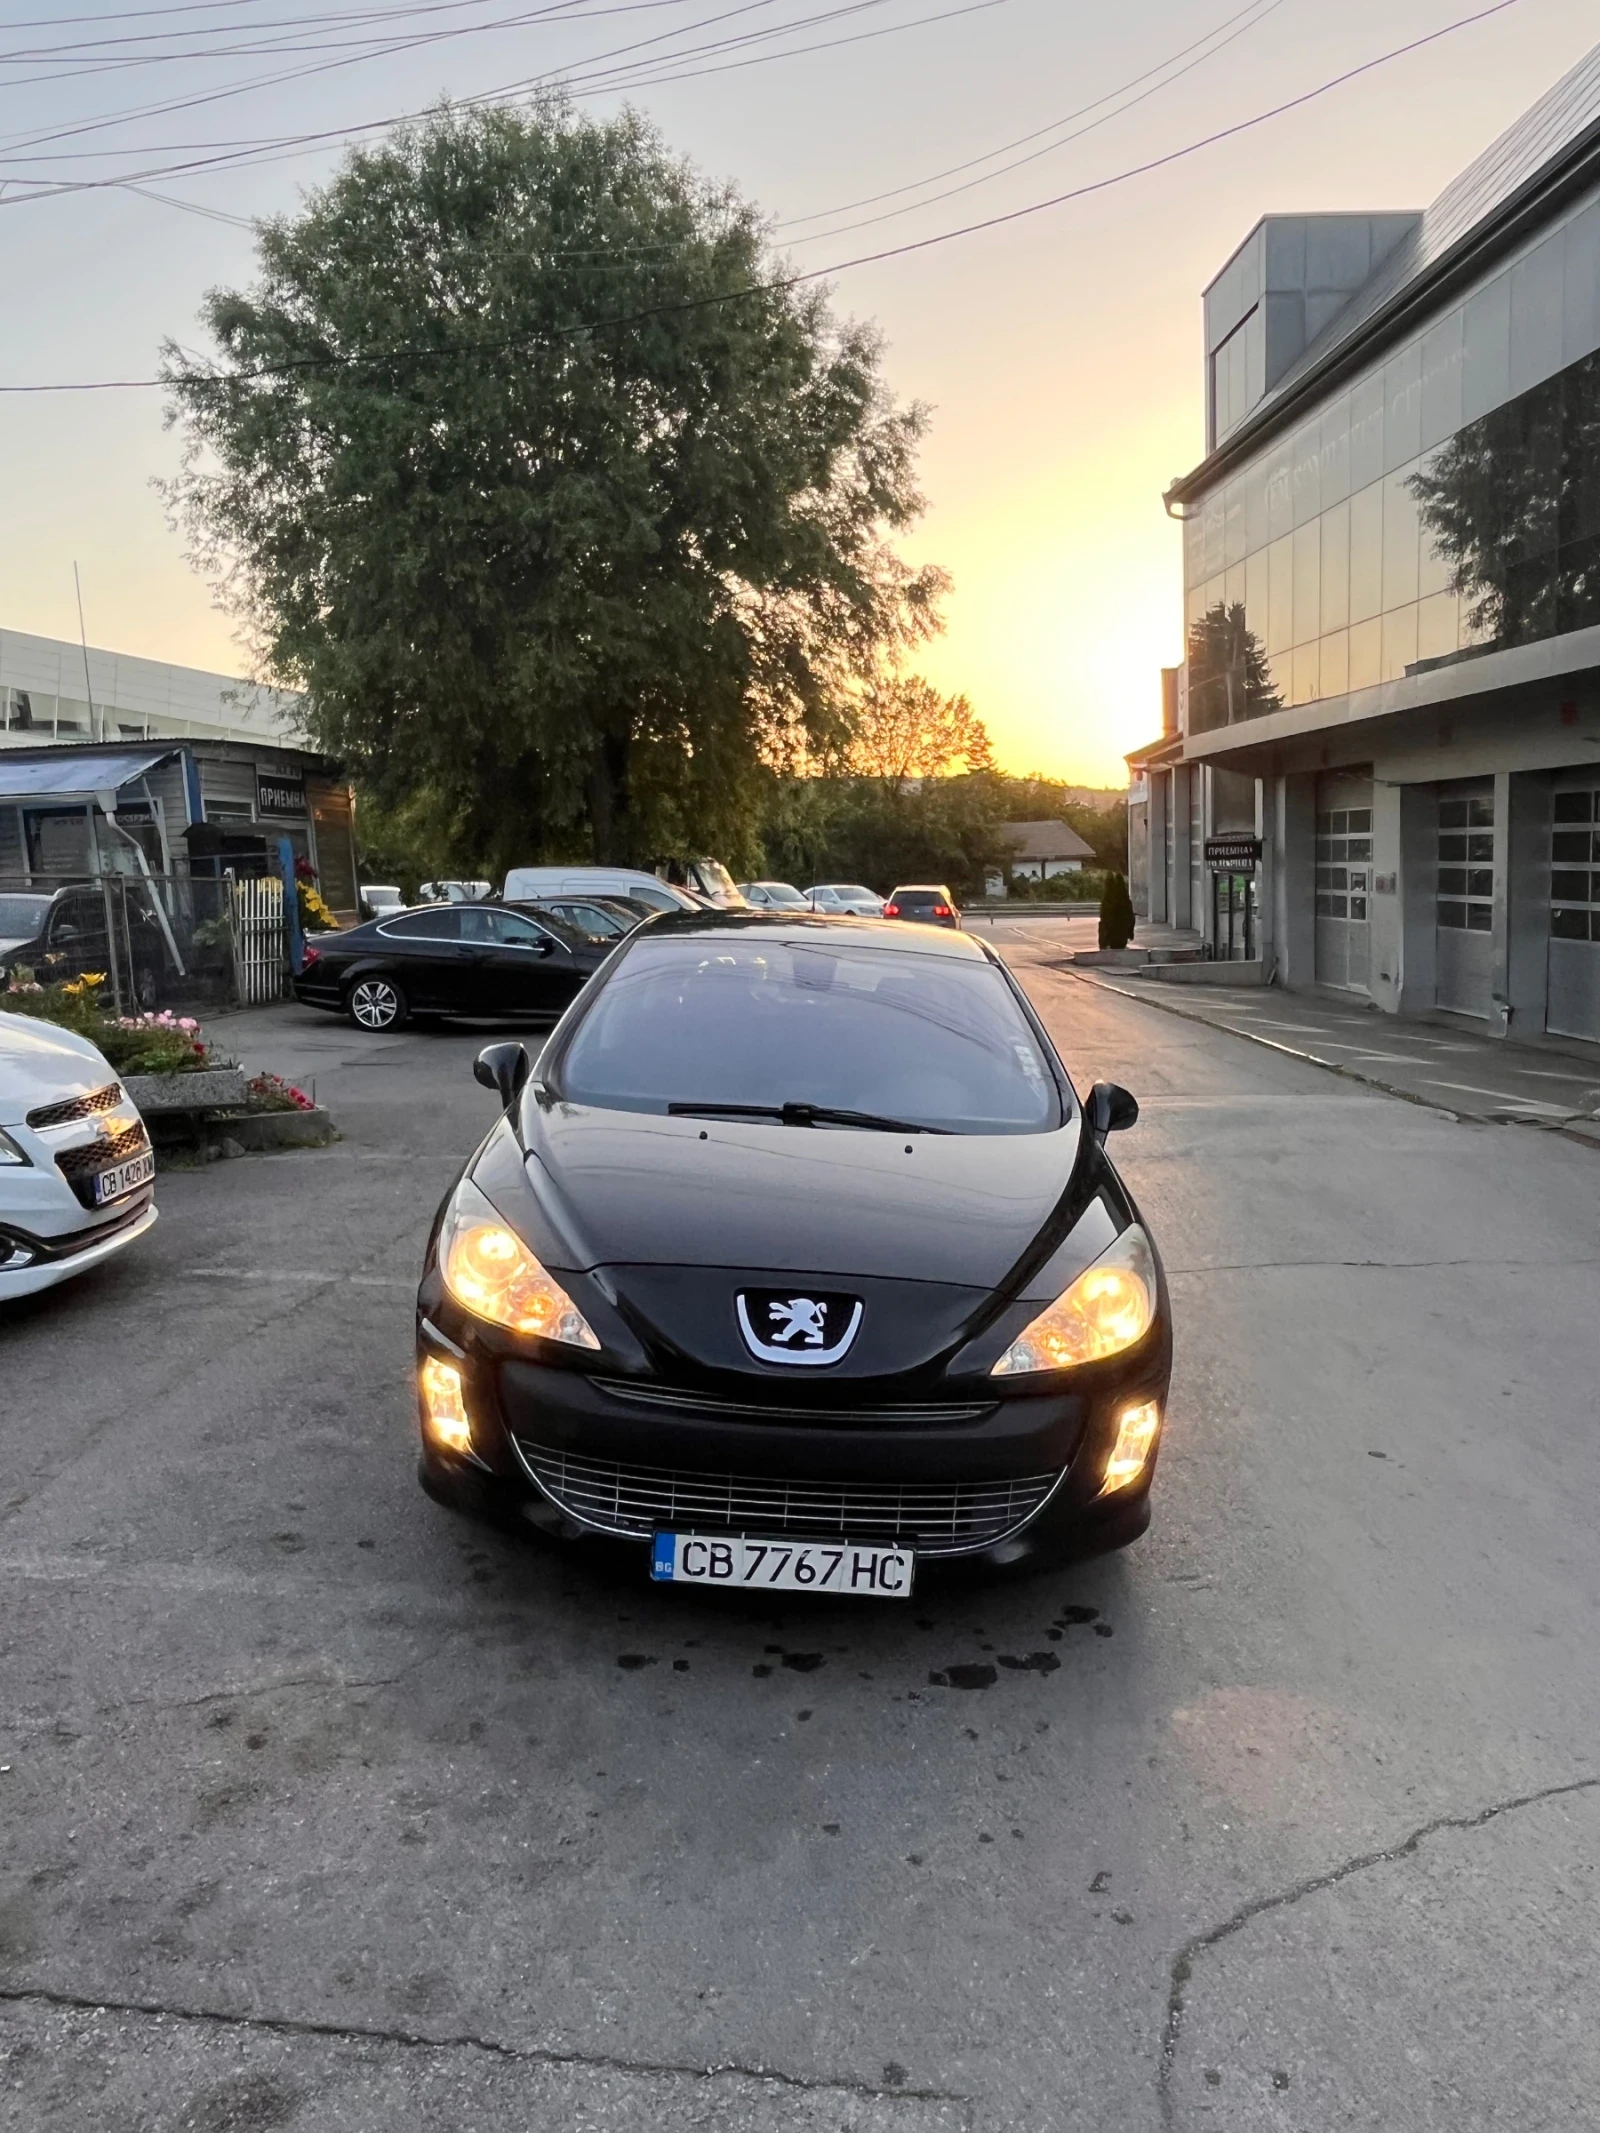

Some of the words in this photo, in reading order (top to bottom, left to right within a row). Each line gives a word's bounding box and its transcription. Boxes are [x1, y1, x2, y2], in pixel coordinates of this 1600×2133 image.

[102, 1171, 117, 1197] CB
[655, 1561, 672, 1573] BG
[682, 1541, 734, 1579] CB
[743, 1545, 843, 1586] 7767
[851, 1552, 905, 1591] HC
